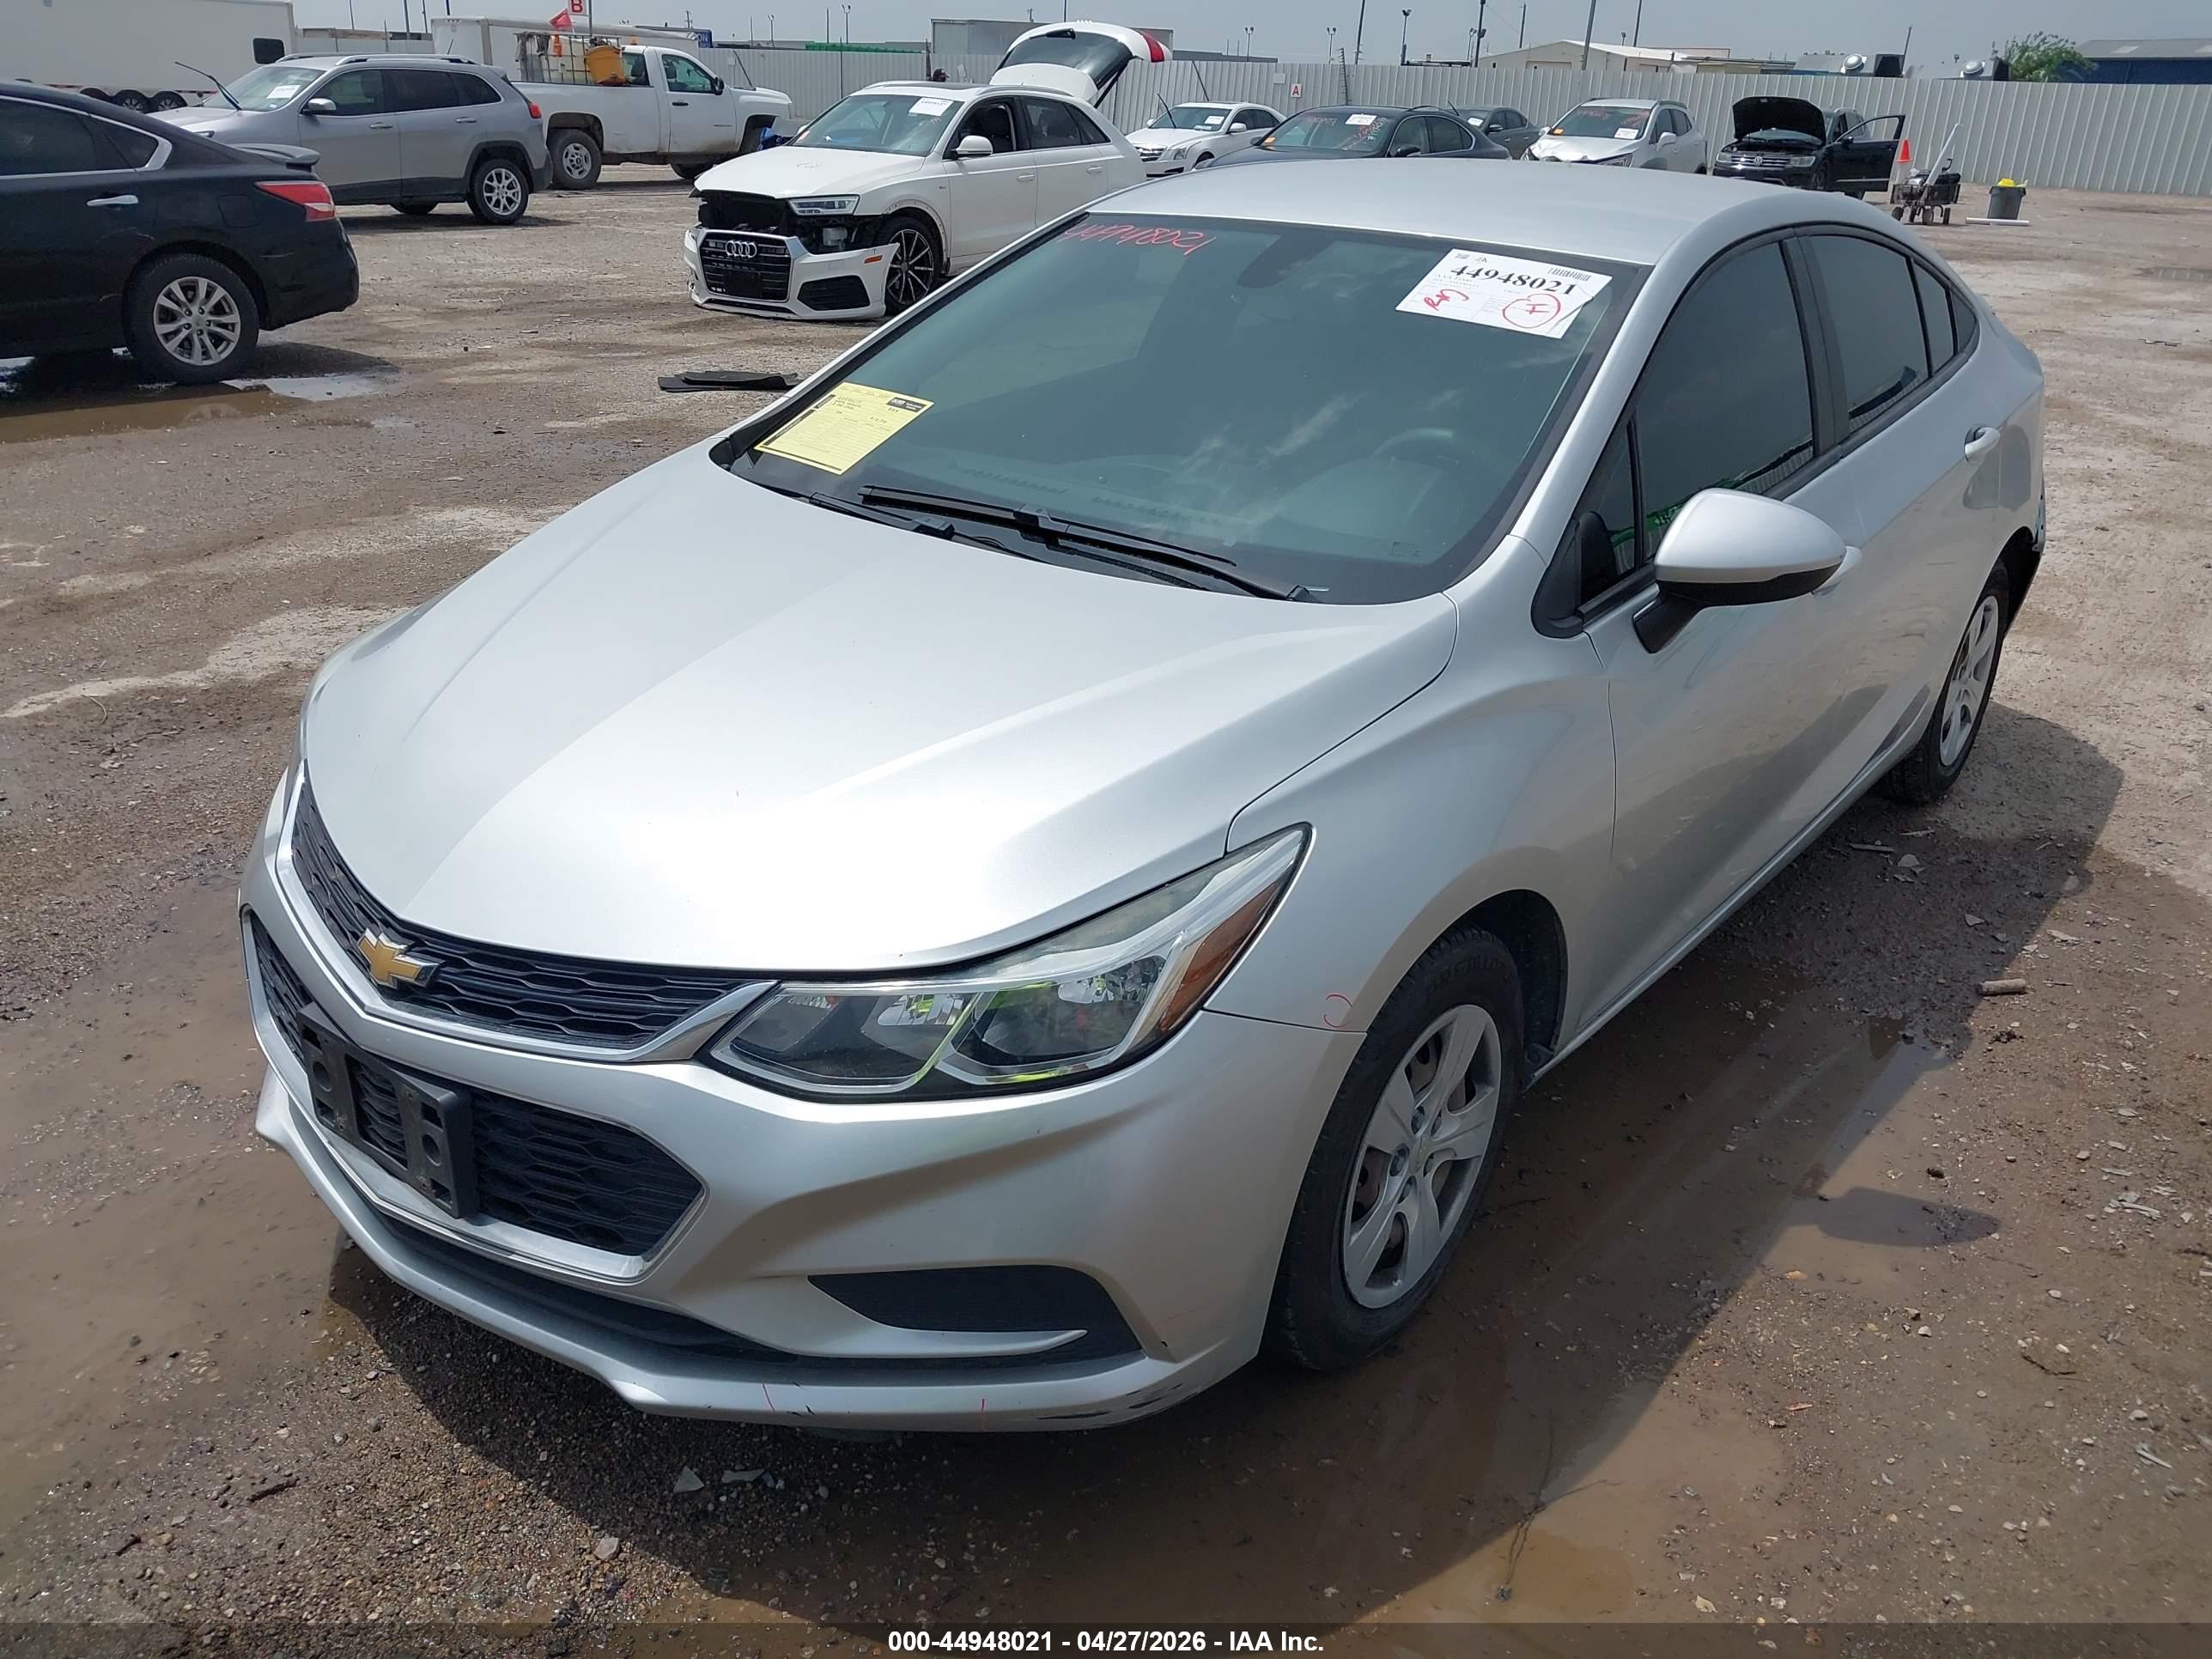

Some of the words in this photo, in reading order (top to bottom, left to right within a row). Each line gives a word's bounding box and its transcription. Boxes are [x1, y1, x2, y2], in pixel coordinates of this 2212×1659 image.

[571, 0, 583, 13] B
[1291, 85, 1299, 96] A
[1449, 264, 1577, 296] 44948021
